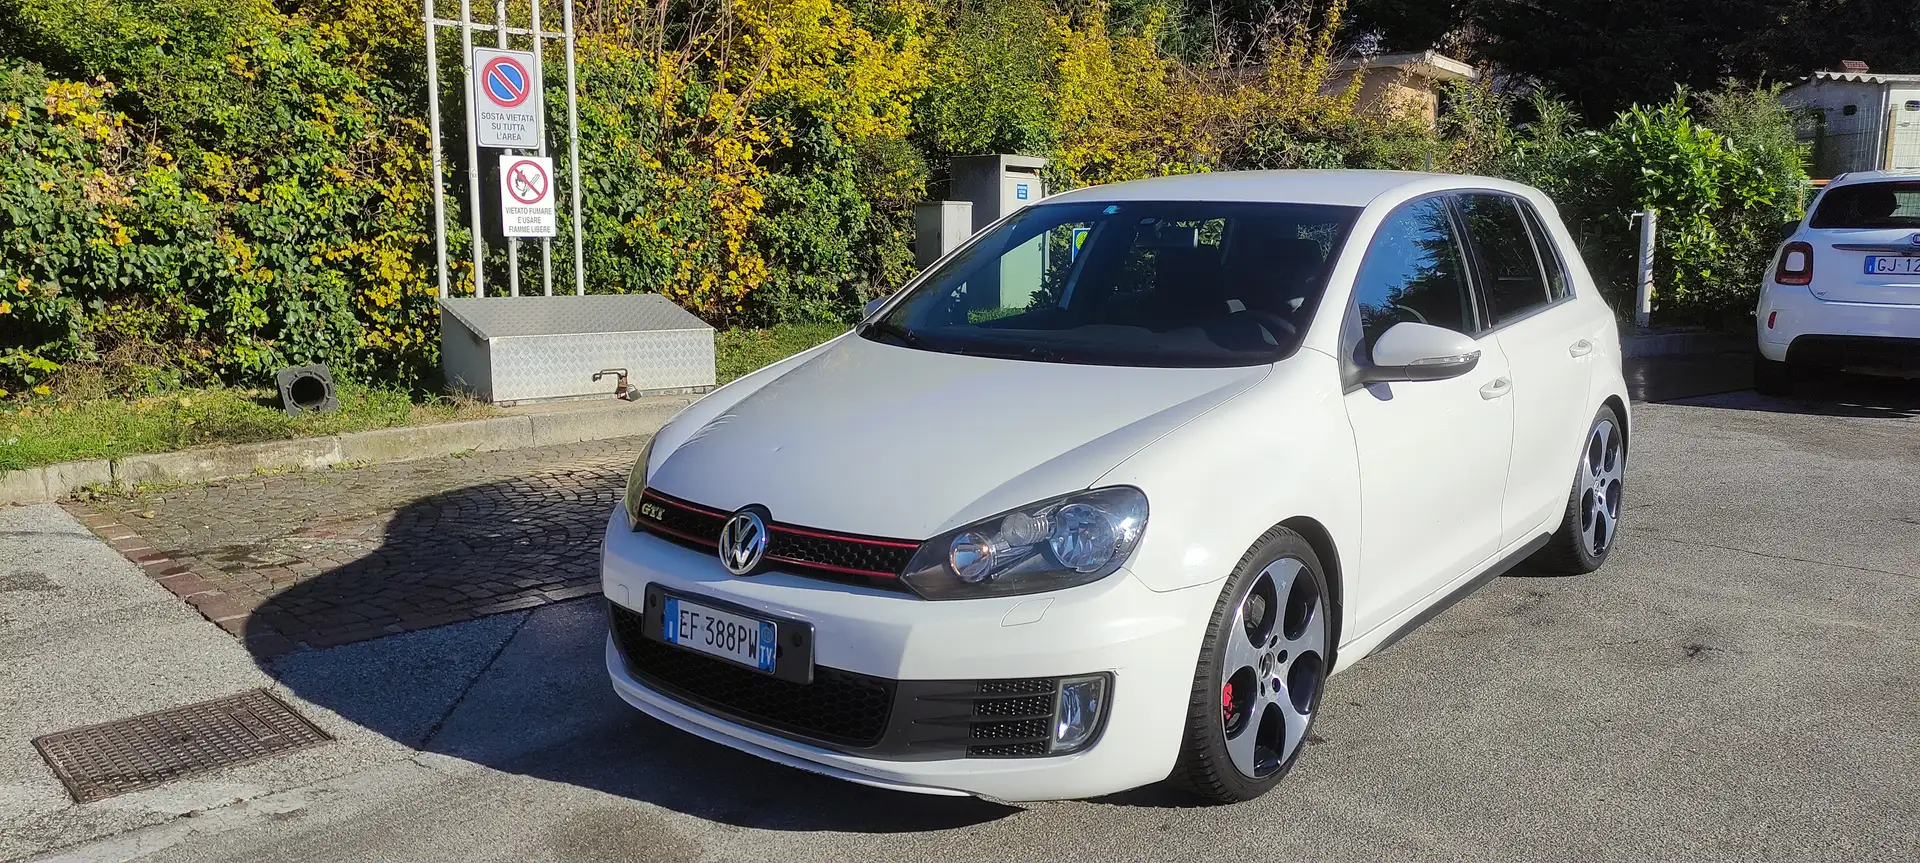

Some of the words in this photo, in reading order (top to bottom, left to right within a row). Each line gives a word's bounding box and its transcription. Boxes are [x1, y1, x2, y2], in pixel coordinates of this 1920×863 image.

[481, 112, 504, 120] SOSTA
[506, 113, 535, 122] VIETATA
[491, 122, 501, 130] SU
[503, 123, 526, 131] TUTTA
[496, 132, 522, 141] L'AREA
[505, 206, 528, 214] VIETATO
[529, 207, 552, 215] FUMARE
[522, 216, 542, 224] USARE
[509, 225, 530, 233] FIAMME
[1877, 258, 1897, 272] GJ
[641, 503, 665, 520] GTI
[679, 610, 700, 640] EF
[705, 616, 758, 659] 388PW
[760, 645, 773, 665] TV
